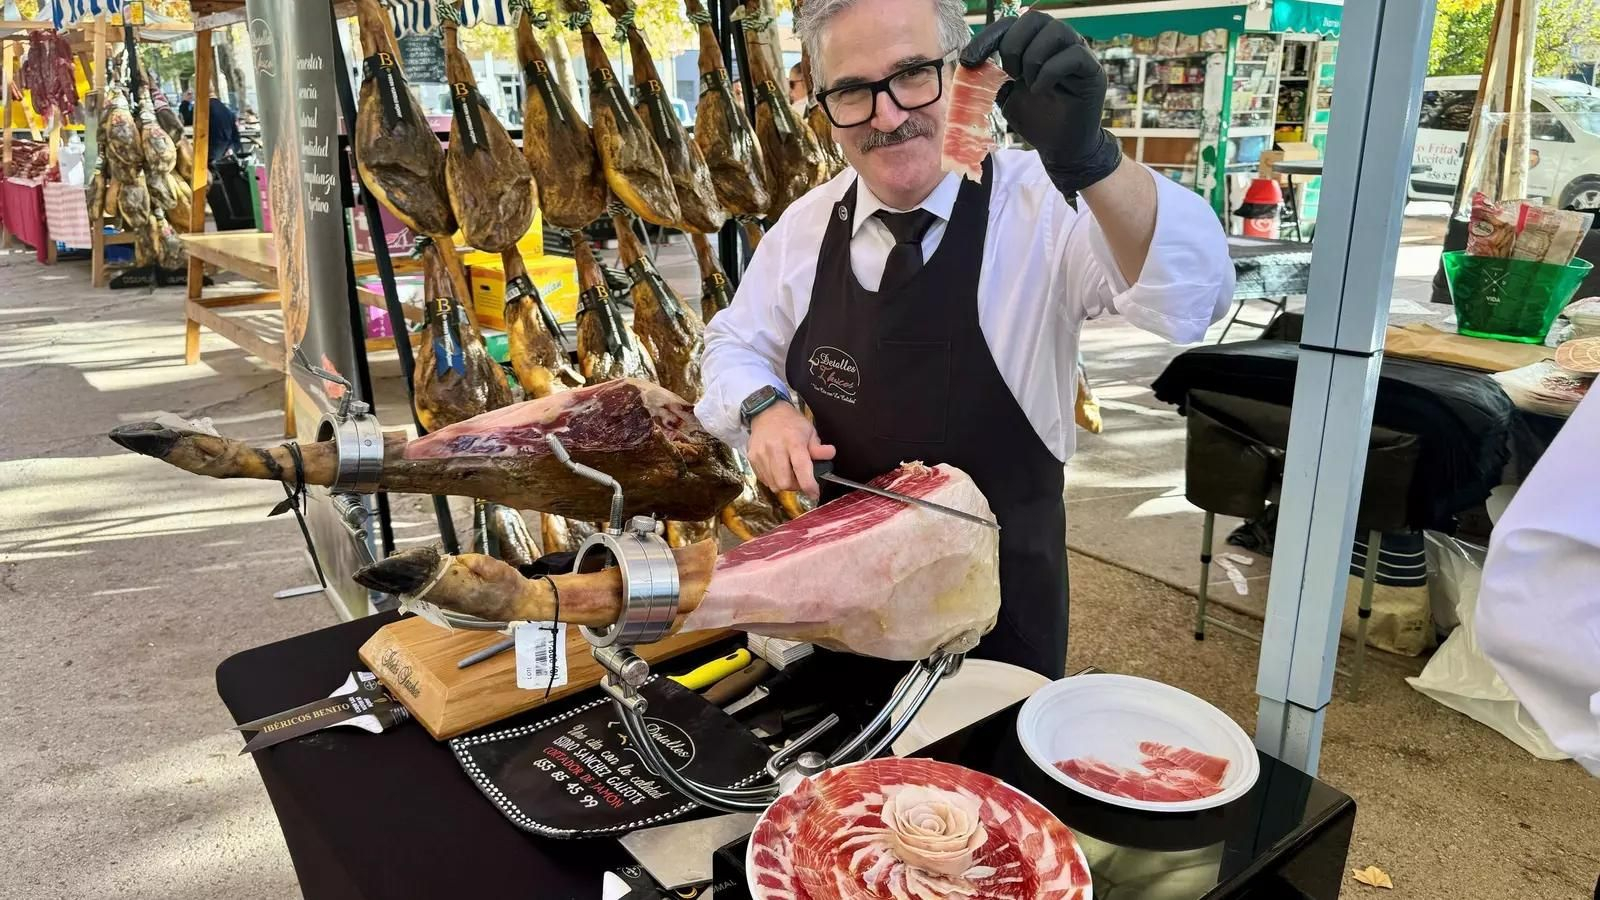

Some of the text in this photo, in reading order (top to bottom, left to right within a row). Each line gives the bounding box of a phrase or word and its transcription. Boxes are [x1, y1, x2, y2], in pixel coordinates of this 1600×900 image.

[377, 52, 393, 66] B
[533, 60, 547, 73] B
[600, 68, 613, 80] B
[454, 82, 469, 96] B
[648, 79, 661, 92] B
[765, 80, 776, 92] B
[712, 273, 725, 285] B
[595, 285, 609, 298] B
[436, 298, 451, 312] B
[819, 352, 857, 373] Detalles
[262, 711, 312, 734] IBÉRICOS
[312, 702, 351, 719] BENITO
[552, 735, 580, 751] ISIDRO
[647, 723, 690, 758] Detalles
[542, 747, 625, 809] CORTADOR DE JAMÓN
[601, 750, 619, 765] con
[617, 763, 635, 776] la
[630, 776, 671, 799] calidad
[533, 758, 599, 808] 655 85 45 99
